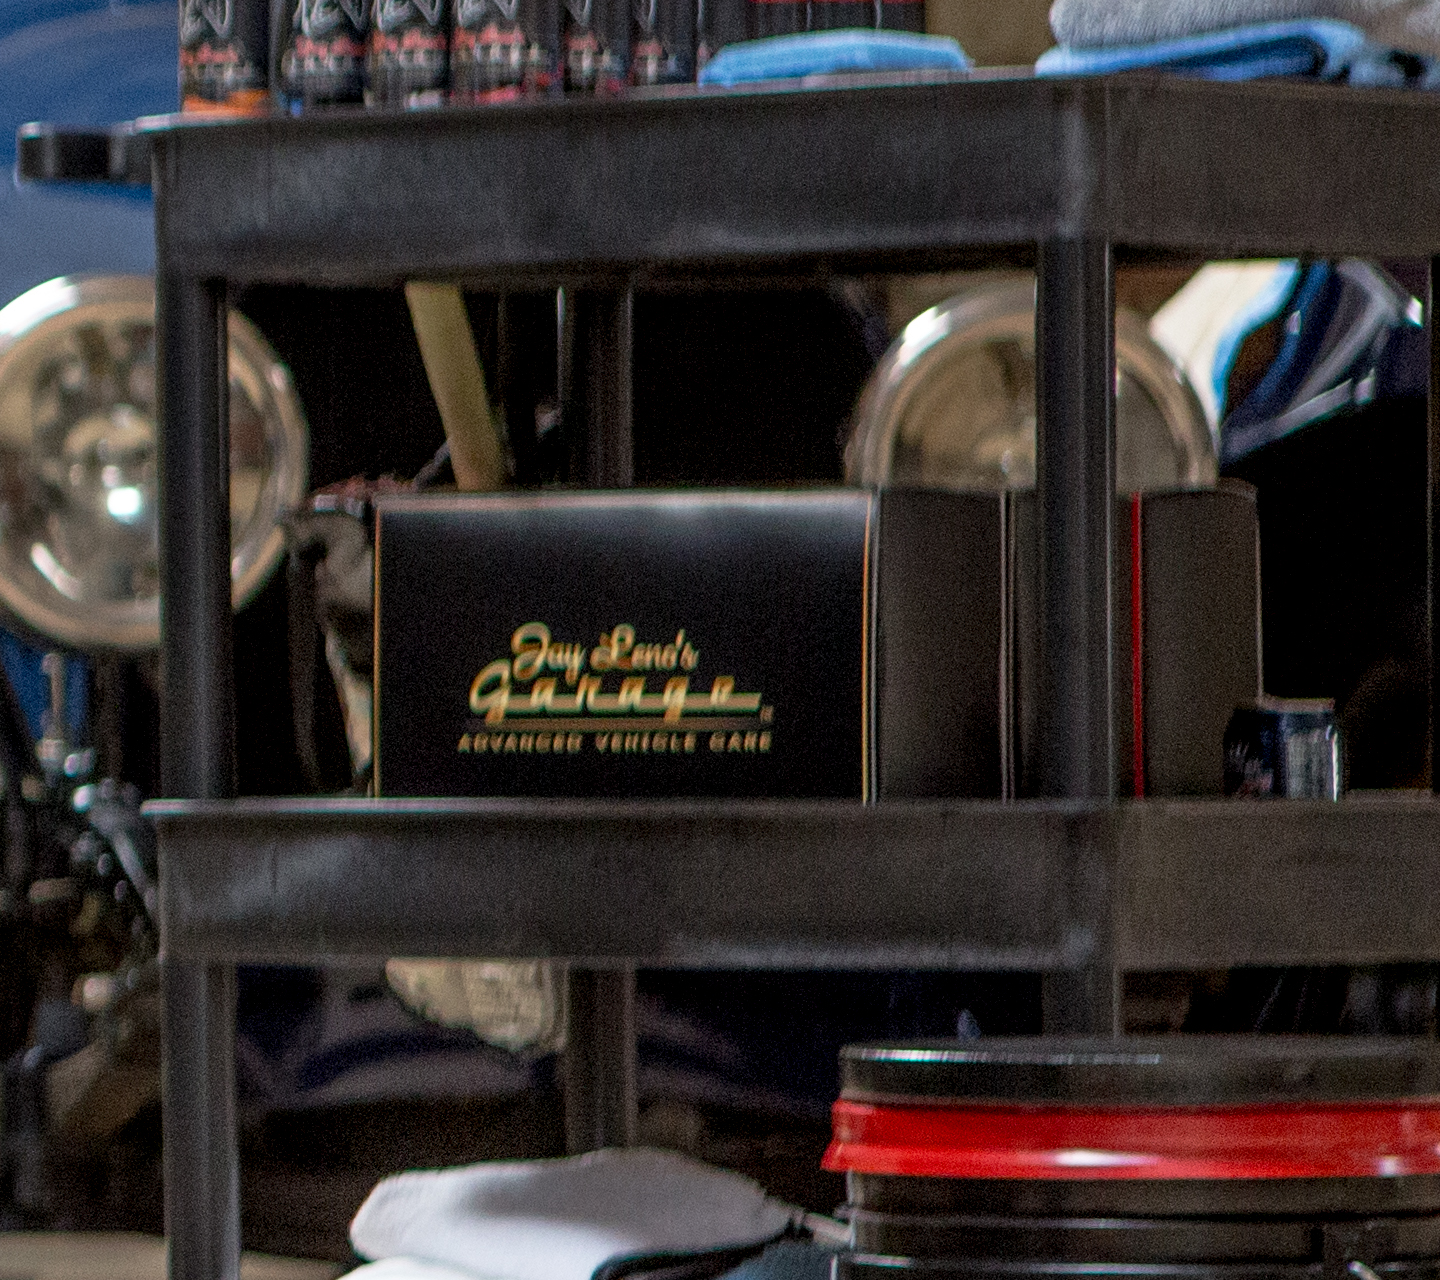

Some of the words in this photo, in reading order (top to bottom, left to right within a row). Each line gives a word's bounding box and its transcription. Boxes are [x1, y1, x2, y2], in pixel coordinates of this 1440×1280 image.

[511, 622, 585, 684] Jay
[590, 624, 699, 670] Leno's
[469, 658, 760, 724] Garage
[457, 732, 582, 753] ADVANCED
[595, 732, 697, 753] VEHICLE
[710, 732, 772, 753] CARE
